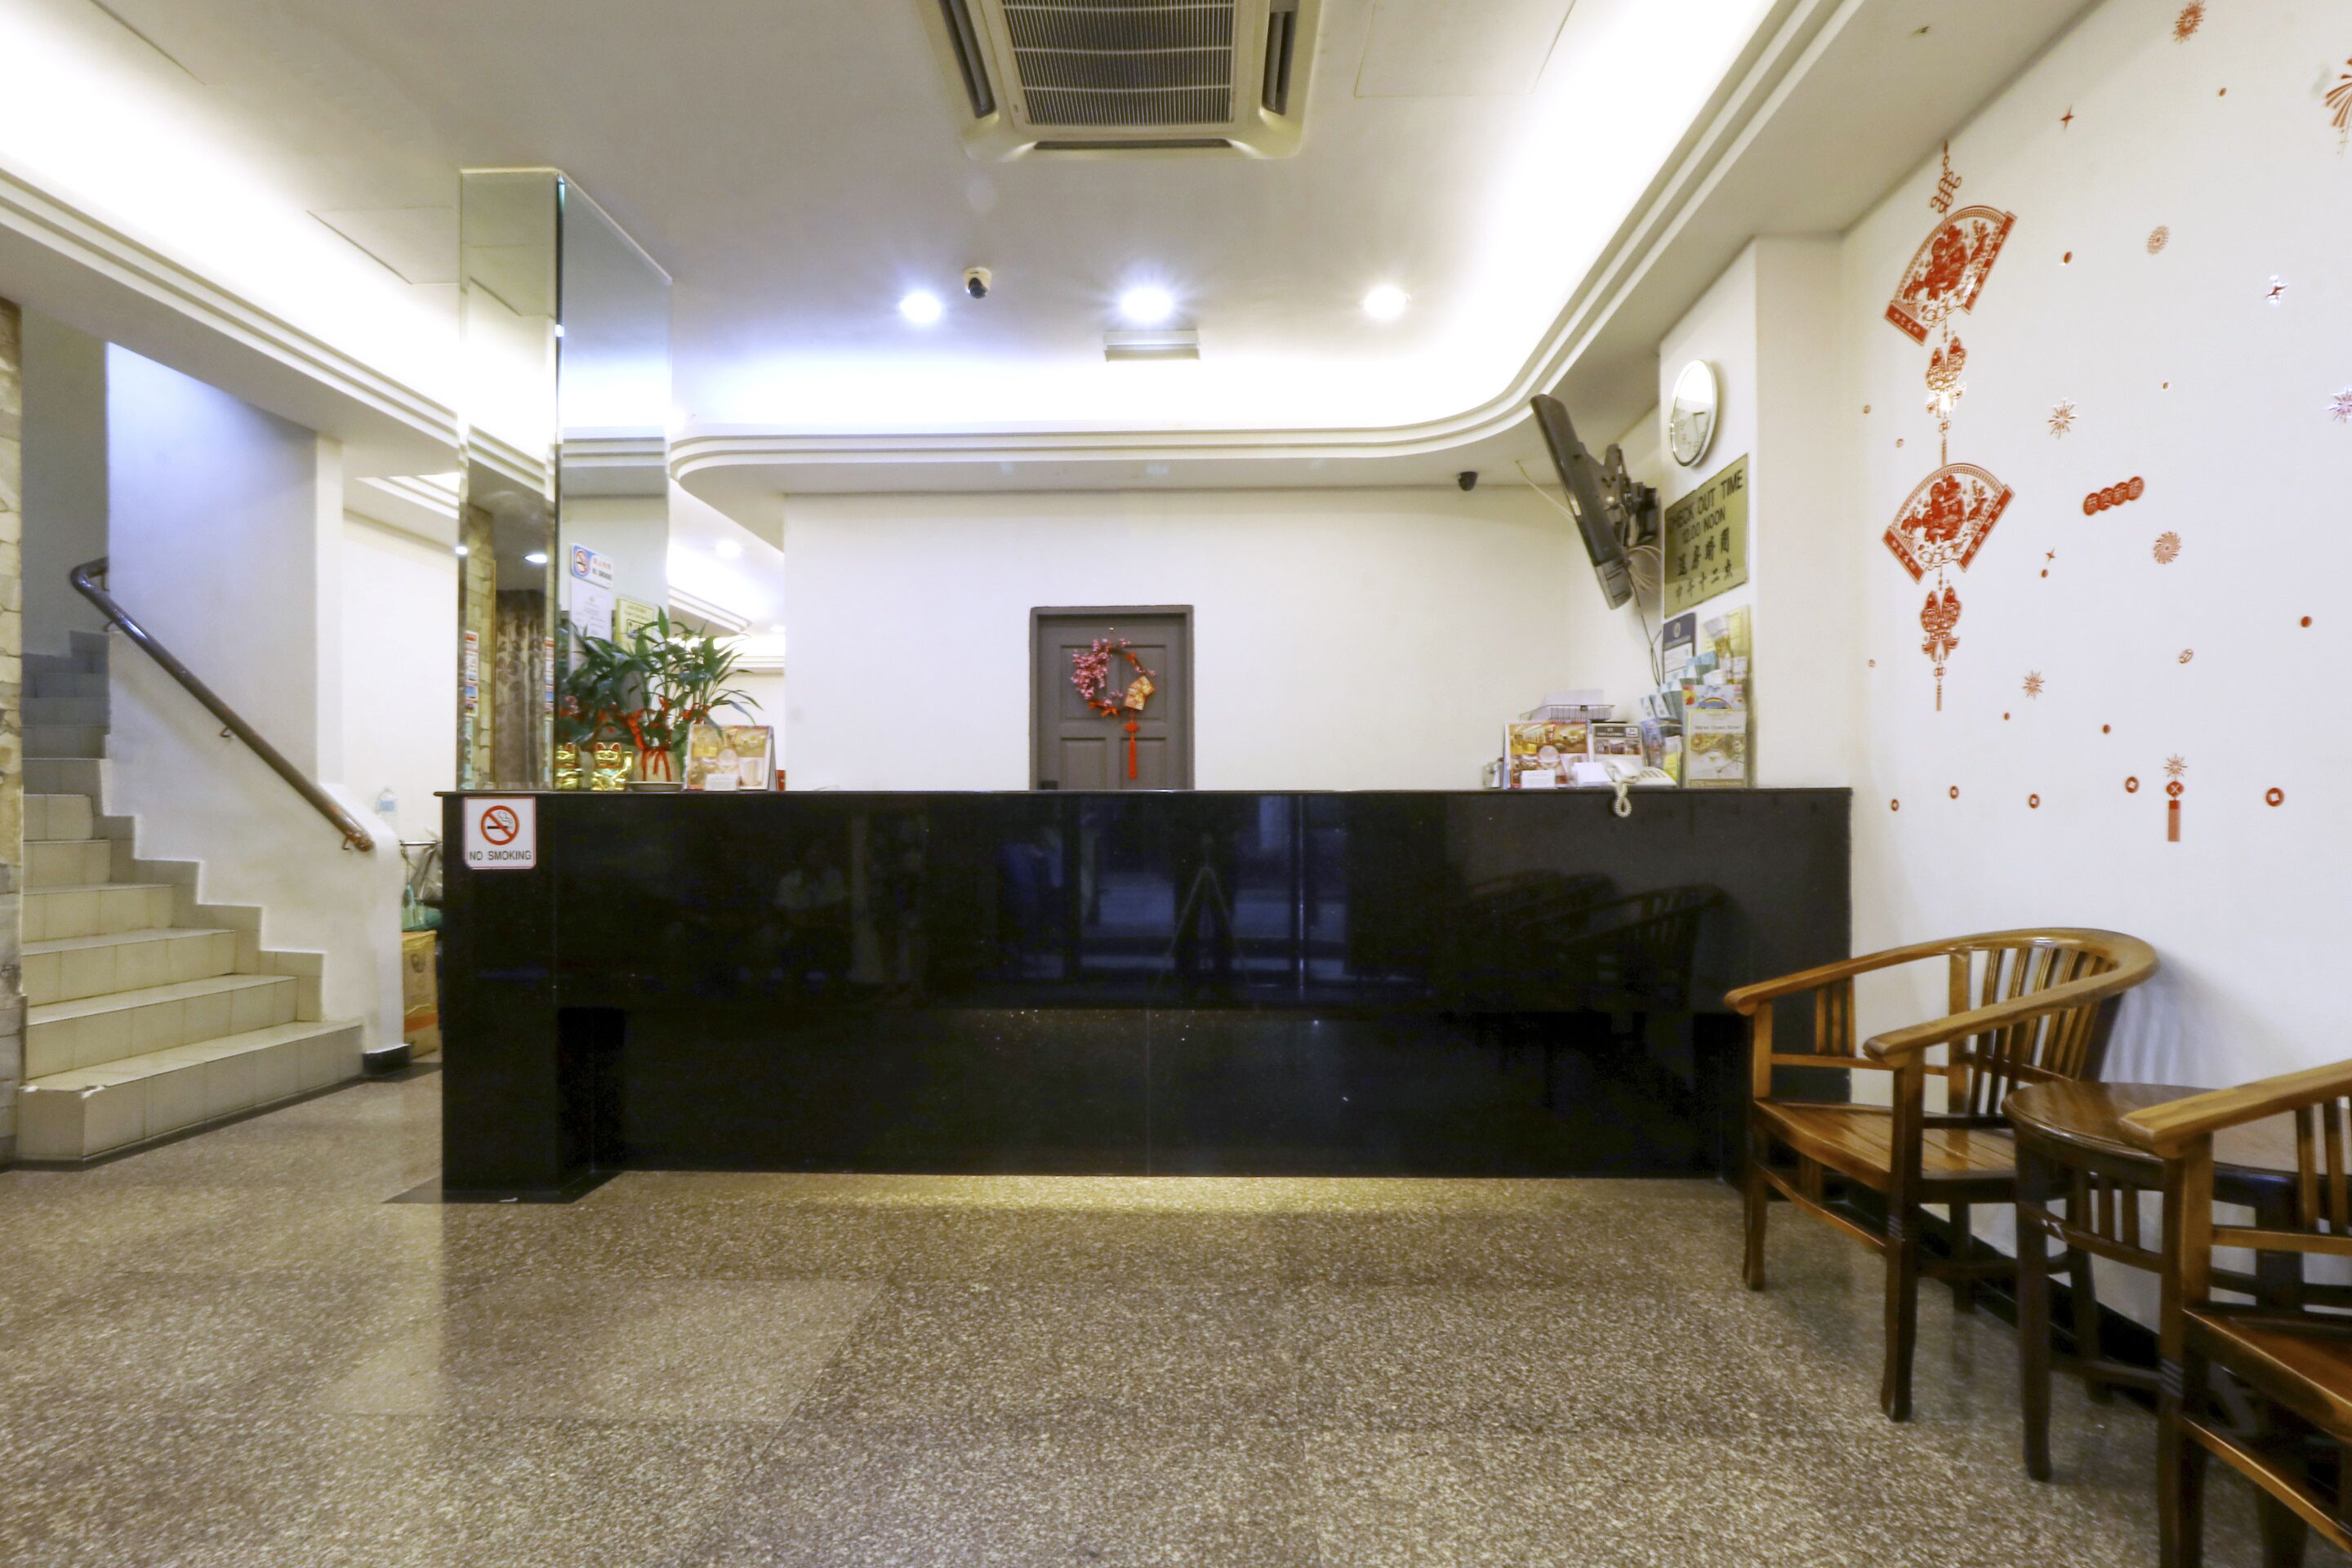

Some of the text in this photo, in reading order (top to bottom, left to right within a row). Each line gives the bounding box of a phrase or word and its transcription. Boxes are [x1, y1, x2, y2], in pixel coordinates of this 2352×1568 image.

[1668, 470, 1744, 532] HECK OUT TIME
[1704, 506, 1726, 532] NOON
[470, 850, 532, 861] NO SMOKING
